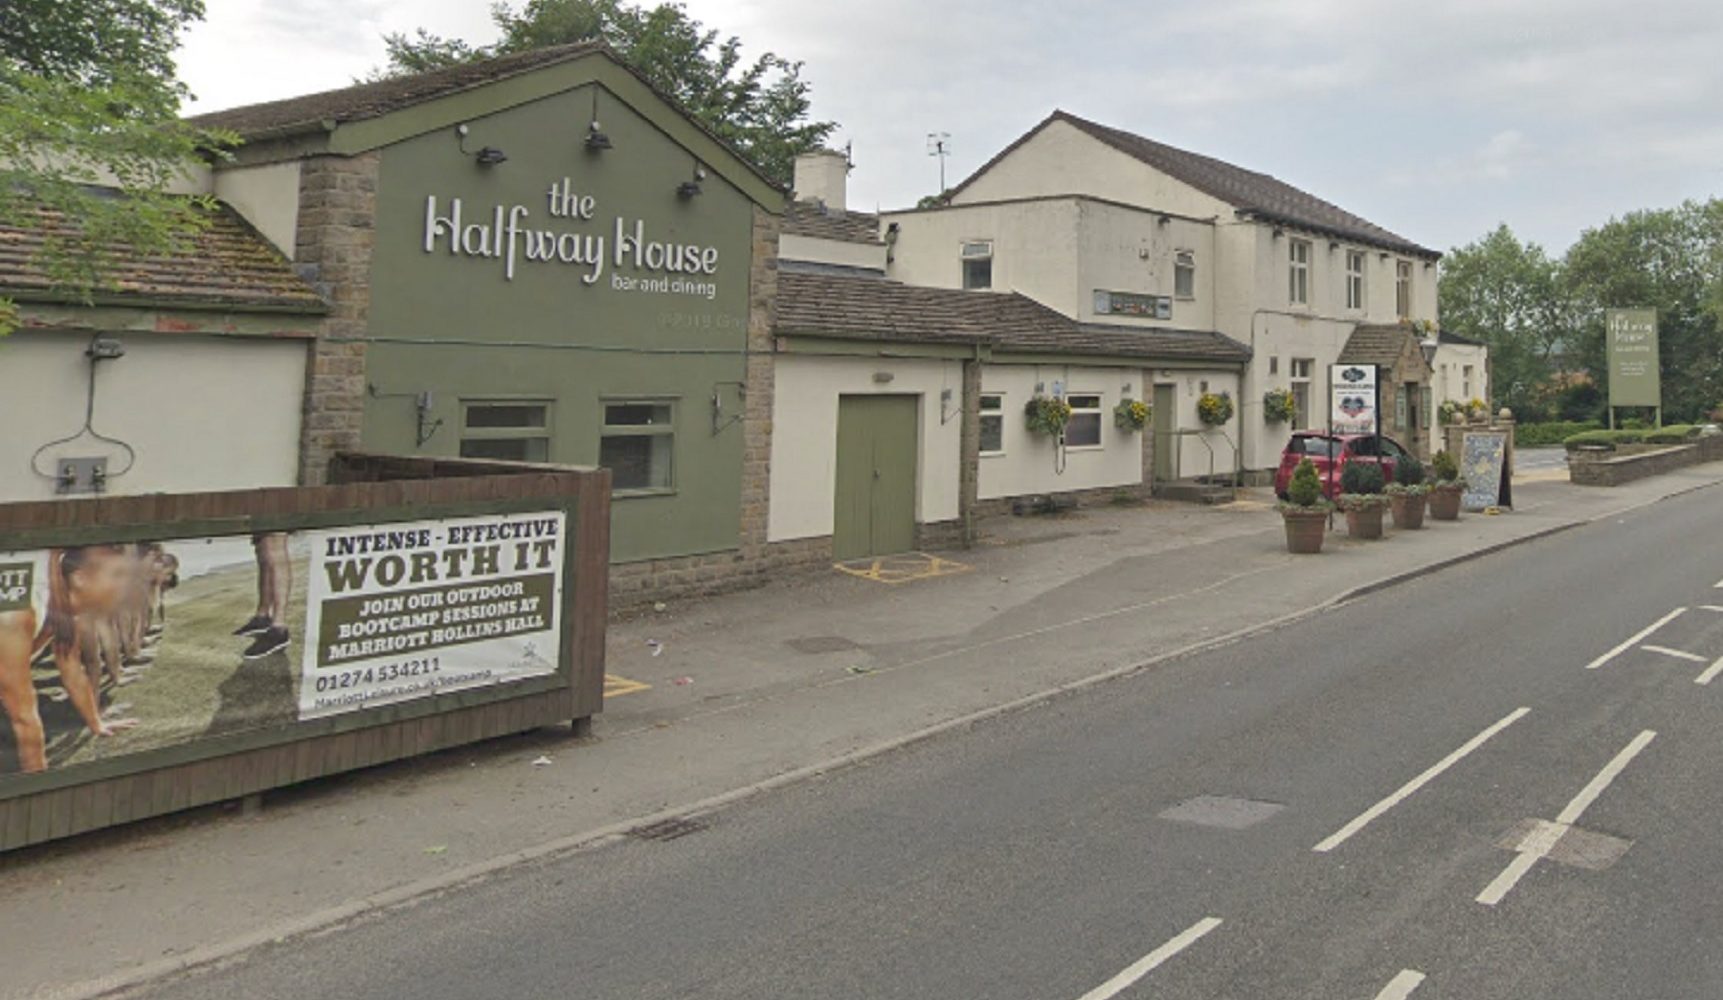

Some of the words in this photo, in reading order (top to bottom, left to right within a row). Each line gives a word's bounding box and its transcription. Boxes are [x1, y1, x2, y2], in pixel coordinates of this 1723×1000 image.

[548, 177, 595, 219] the
[425, 195, 604, 284] Halfway
[615, 216, 719, 274] House
[611, 272, 637, 291] bar
[640, 276, 668, 293] and
[671, 278, 716, 300] dining
[326, 529, 430, 557] INTENSE
[447, 518, 558, 545] EFFECTIVE
[0, 570, 29, 586] TT
[324, 545, 500, 593] WORTH
[514, 540, 556, 571] IT
[337, 609, 441, 639] BOOTCAMP
[442, 600, 518, 624] SESSIONS
[519, 597, 541, 613] AT
[359, 596, 404, 617] JOIN
[408, 590, 444, 610] OUR
[447, 581, 524, 605] OUTDOOR
[328, 630, 429, 661] MARRIOTT
[432, 620, 501, 643] HOLLINS
[504, 615, 545, 633] HALL
[316, 669, 373, 692] 01274
[377, 657, 440, 682] 534211
